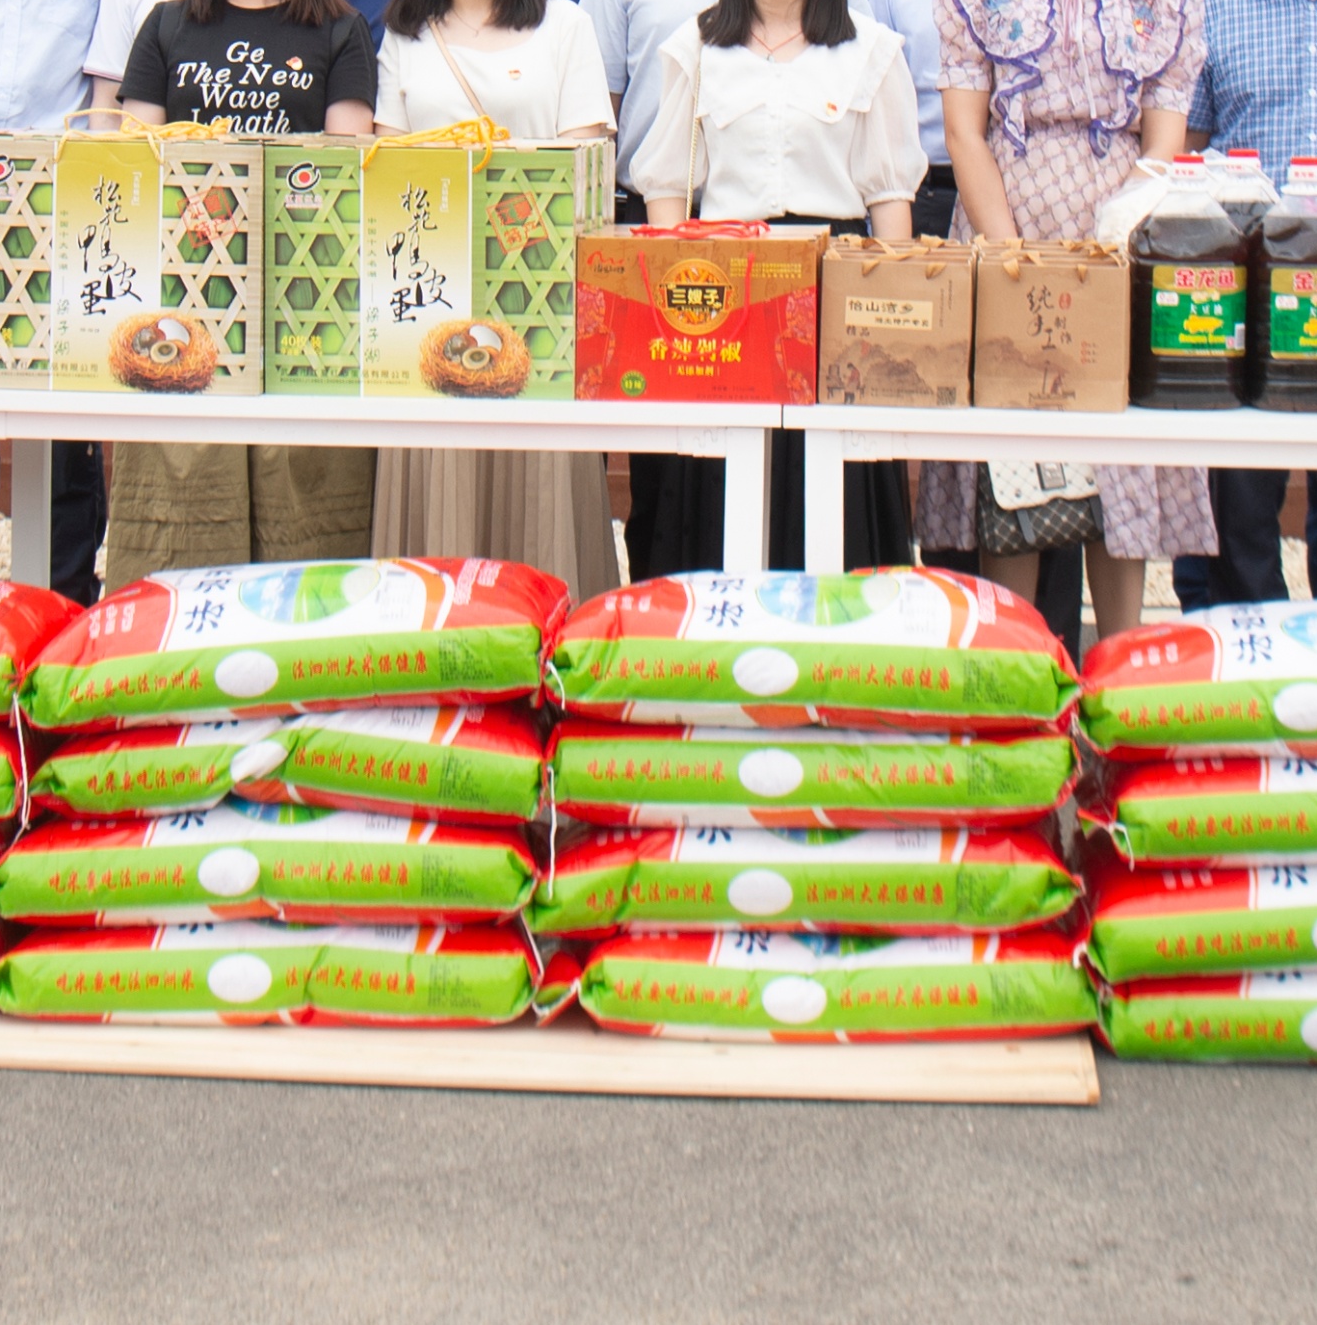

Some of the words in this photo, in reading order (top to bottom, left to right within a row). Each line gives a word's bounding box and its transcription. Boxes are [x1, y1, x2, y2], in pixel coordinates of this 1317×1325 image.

[226, 41, 265, 64] Ge
[177, 62, 231, 87] The
[238, 63, 314, 90] New
[200, 82, 280, 109] Wave
[1175, 267, 1238, 289] 金龙鱼
